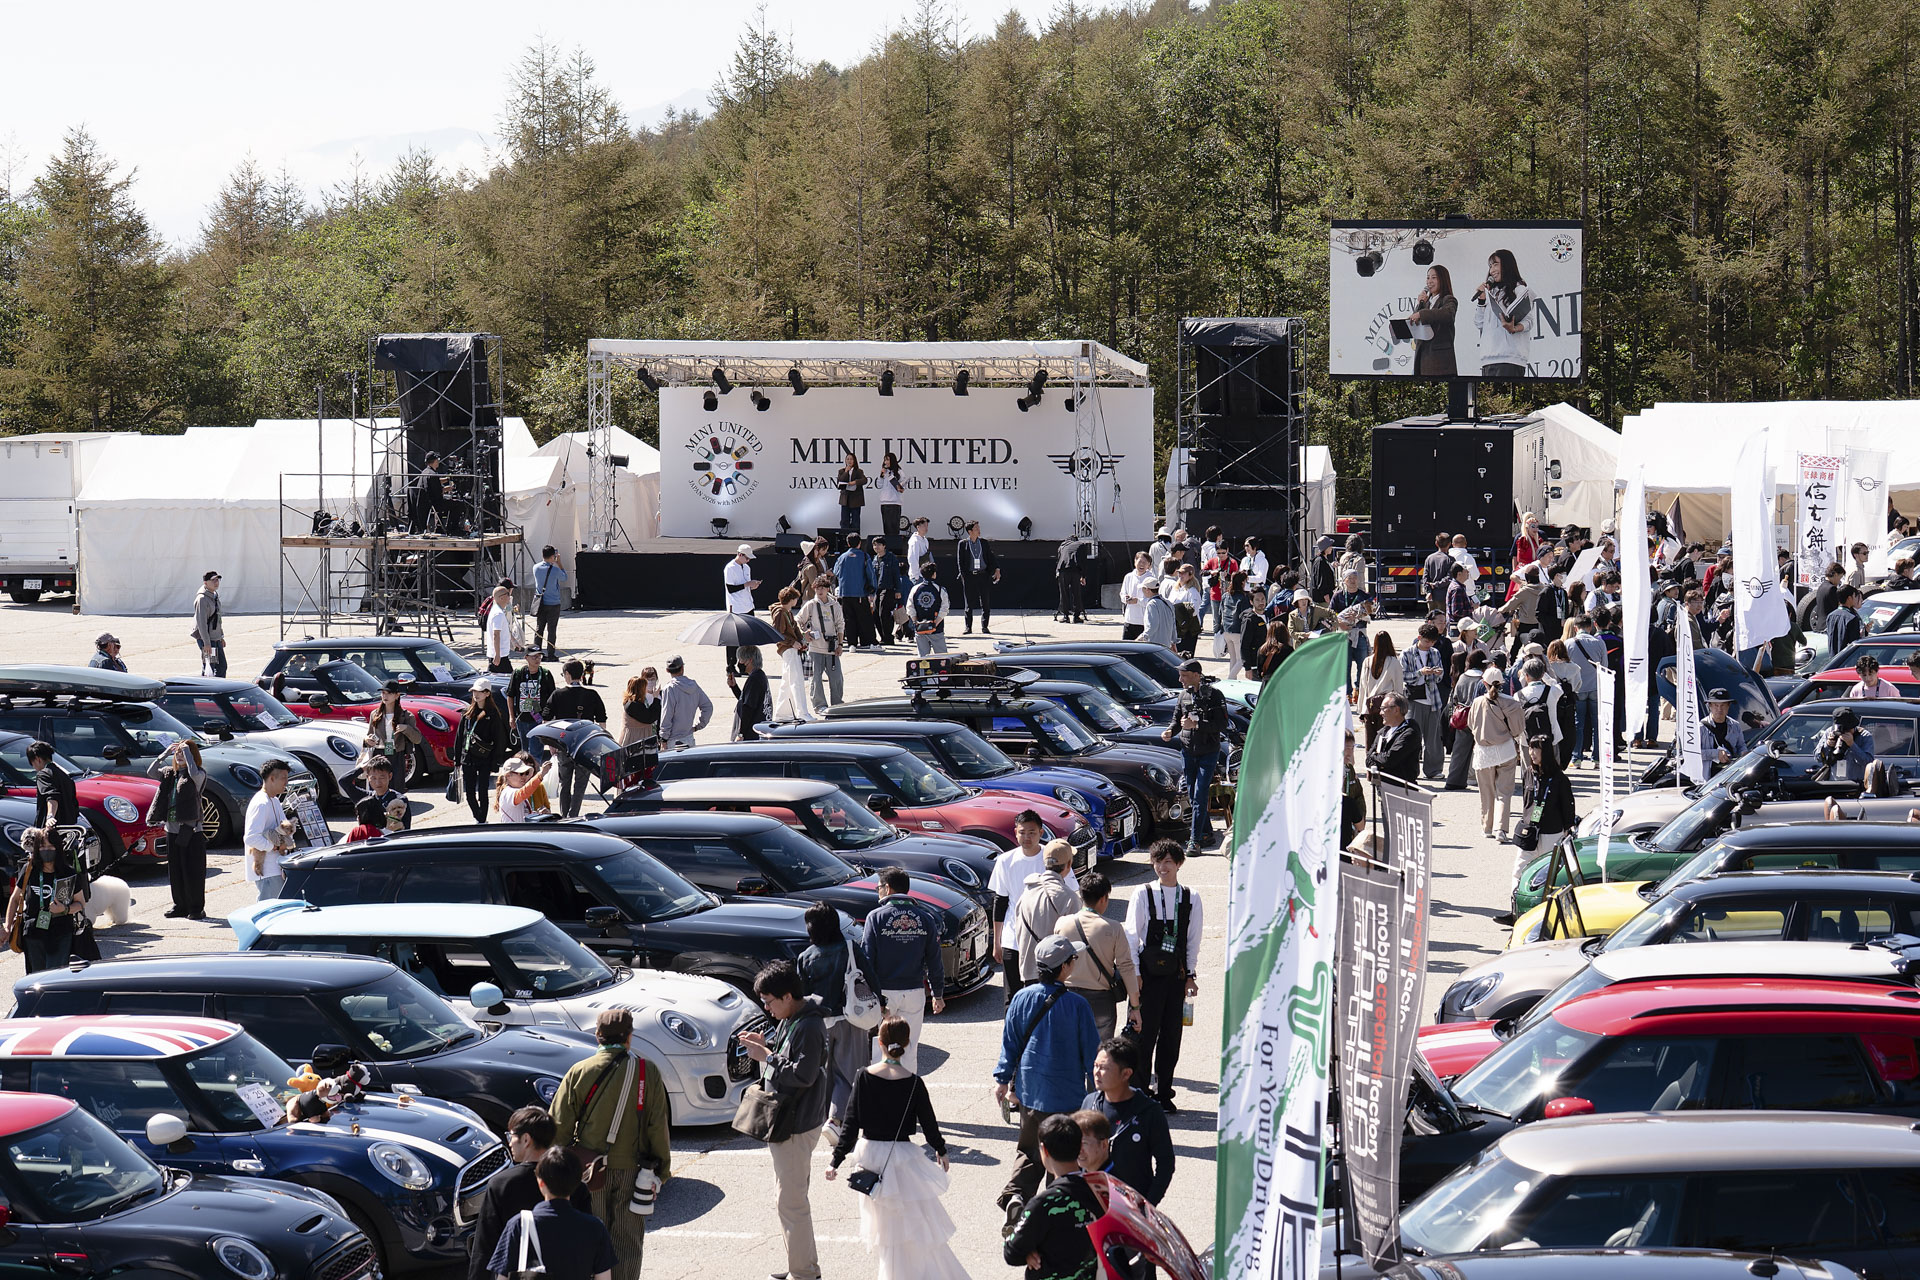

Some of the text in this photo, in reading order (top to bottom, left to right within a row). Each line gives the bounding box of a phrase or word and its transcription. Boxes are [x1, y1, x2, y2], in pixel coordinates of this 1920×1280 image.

[1365, 303, 1393, 345] MINI
[684, 421, 763, 456] MINI UNITED.
[790, 438, 1018, 464] MINI UNITED.
[688, 480, 703, 497] JAPAN
[702, 495, 716, 505] 2026
[731, 494, 746, 505] MINI
[789, 477, 839, 490] JAPAN
[927, 477, 967, 489] MINI
[972, 477, 1018, 490] LIVE!
[1245, 1021, 1279, 1271] For Your Driving
